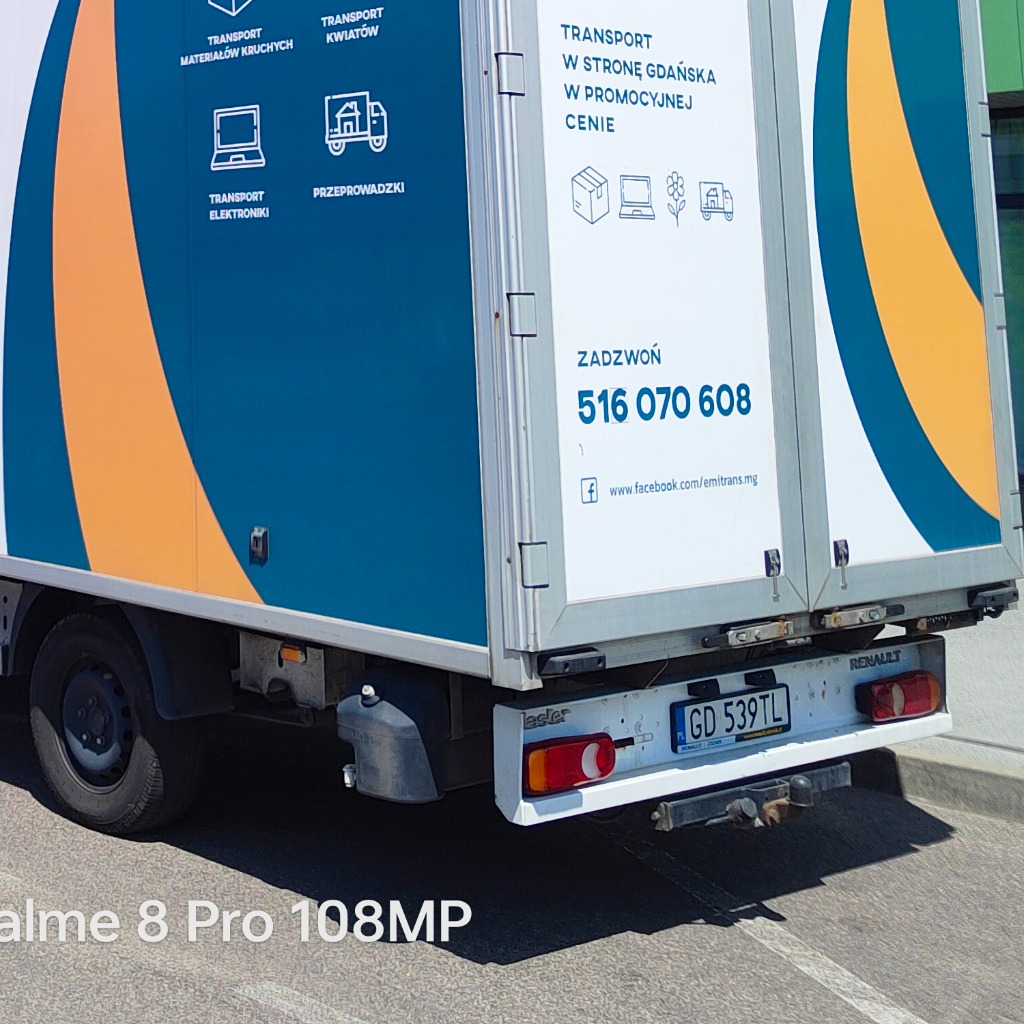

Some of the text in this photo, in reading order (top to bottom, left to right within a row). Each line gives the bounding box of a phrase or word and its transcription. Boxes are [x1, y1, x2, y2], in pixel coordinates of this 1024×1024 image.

[321, 7, 385, 27] TRANSPORT
[207, 28, 263, 46] TRANSPORT
[326, 23, 380, 43] KWIATÓW
[560, 23, 653, 50] TRANSPORT
[180, 39, 294, 66] MATERIAŁÓW KRUCHYCH
[562, 53, 717, 85] W STRONĘ GDAŃSKA
[564, 83, 693, 110] W PROMOCYJNEJ
[565, 113, 615, 133] CENIE
[209, 190, 265, 205] TRANSPORT
[313, 181, 405, 198] PRZEPROWADZKI
[209, 207, 270, 221] ELEKTRONIKI
[577, 342, 661, 367] ZADZWOŃ
[578, 383, 752, 424] 516 070 608
[609, 474, 758, 497] www.facebook.com/emitrans.mg
[849, 649, 902, 671] RENAULT
[522, 708, 572, 730] aster
[689, 692, 783, 740] GD 539TL
